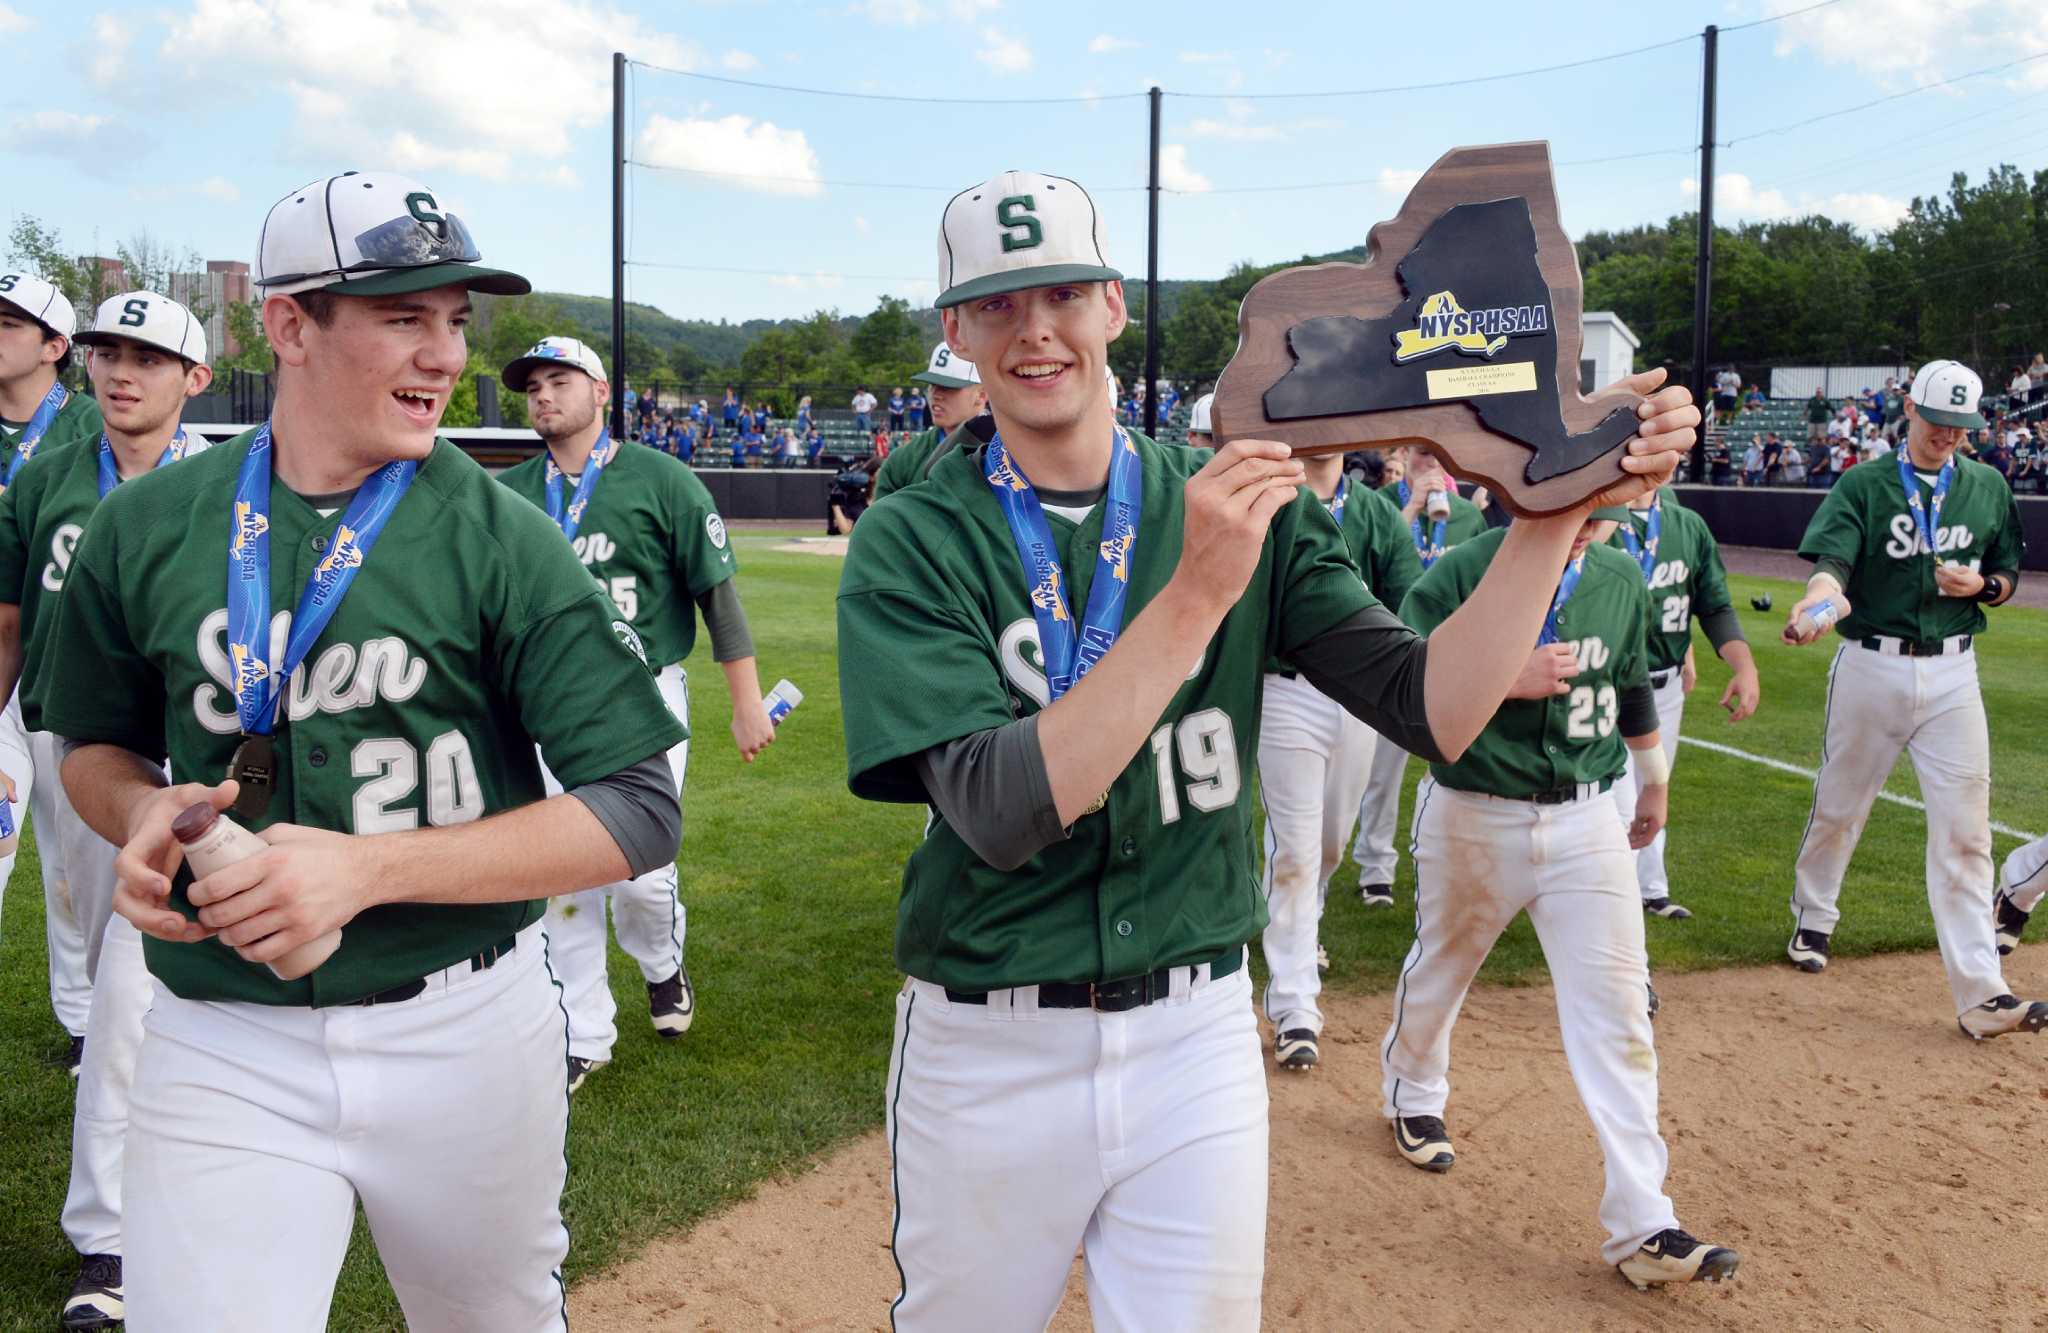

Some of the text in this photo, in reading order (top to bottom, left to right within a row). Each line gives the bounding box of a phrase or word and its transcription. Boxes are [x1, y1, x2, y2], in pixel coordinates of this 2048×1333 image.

[406, 192, 448, 238] S
[997, 194, 1043, 253] S
[0, 274, 20, 292] S
[119, 299, 148, 327] S
[1420, 305, 1547, 339] NYSPHSAA
[935, 348, 950, 368] S
[1950, 385, 1967, 405] S
[242, 513, 256, 582] NYSPHSAA
[313, 540, 354, 607] NYSPHSAA
[1568, 686, 1617, 738] 23
[351, 729, 485, 836] 20
[1151, 707, 1241, 825] 19
